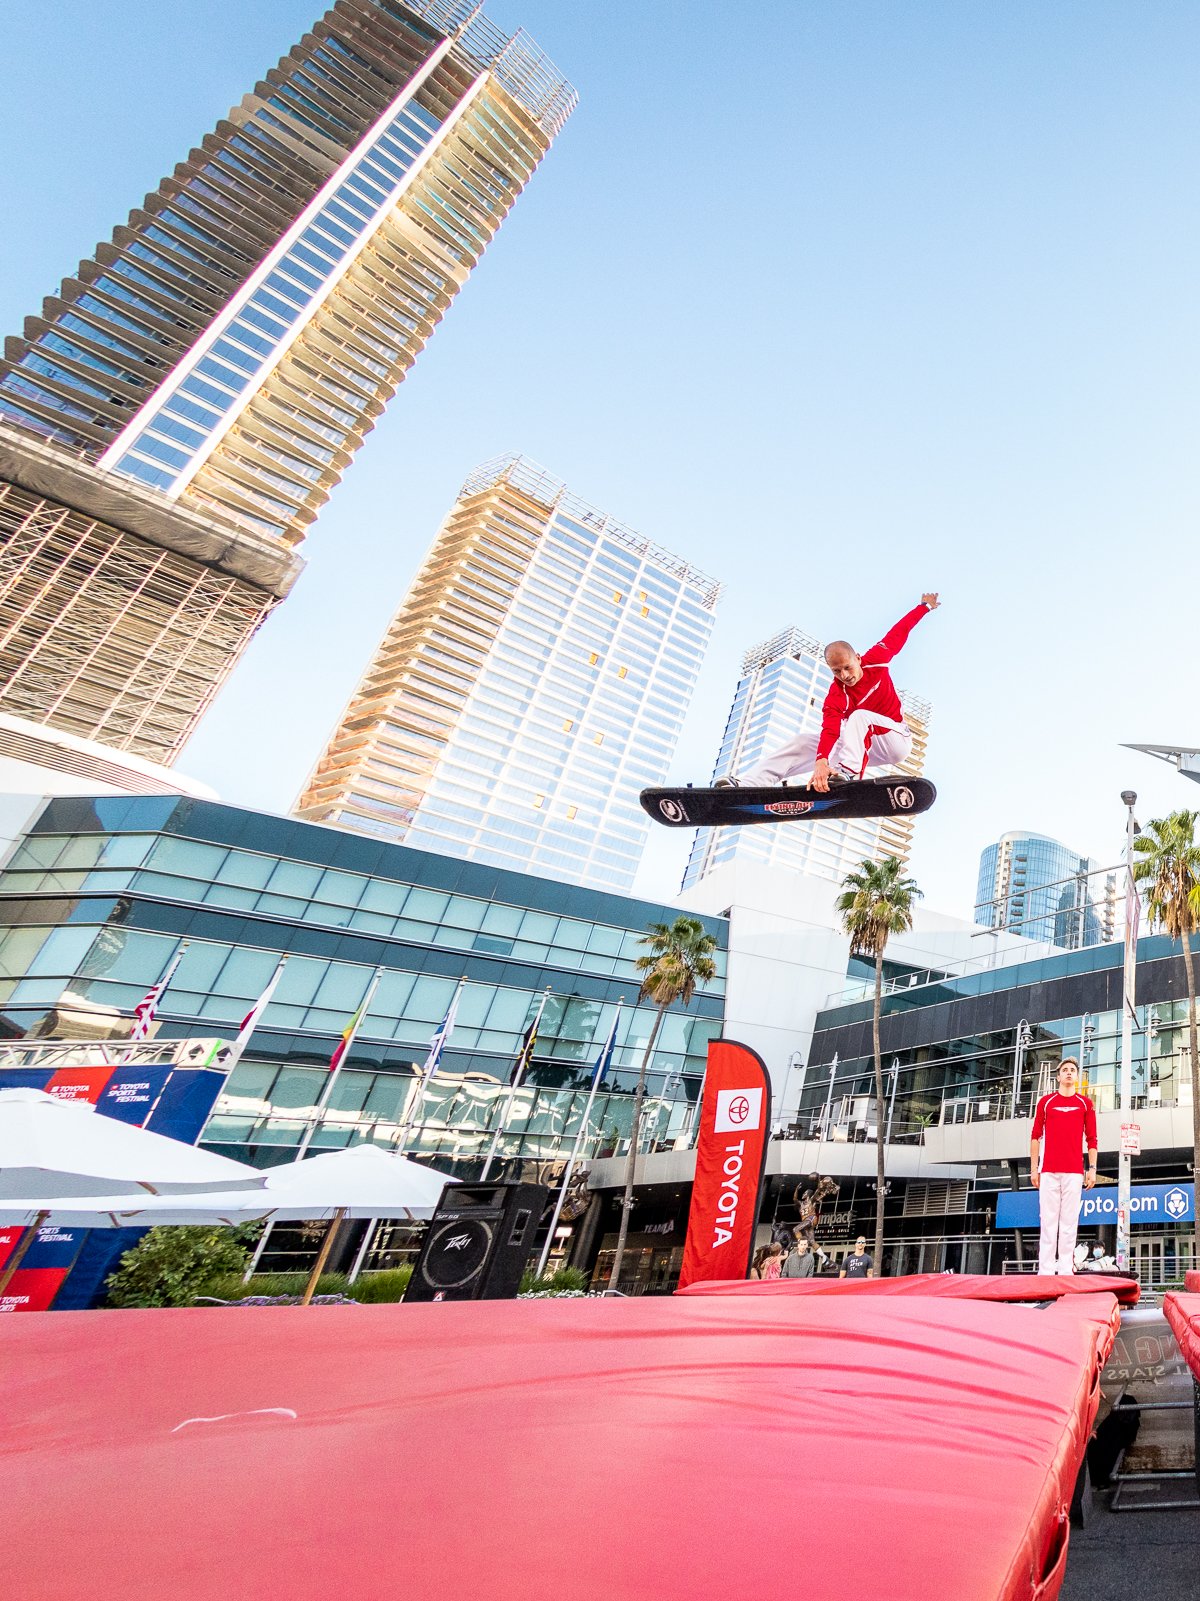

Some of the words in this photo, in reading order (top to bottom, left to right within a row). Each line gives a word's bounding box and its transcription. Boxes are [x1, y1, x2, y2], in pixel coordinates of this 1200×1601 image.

[713, 1140, 745, 1248] TOYOTA
[39, 1234, 74, 1242] FESTIVAL
[2, 1296, 30, 1304] TOYOTA
